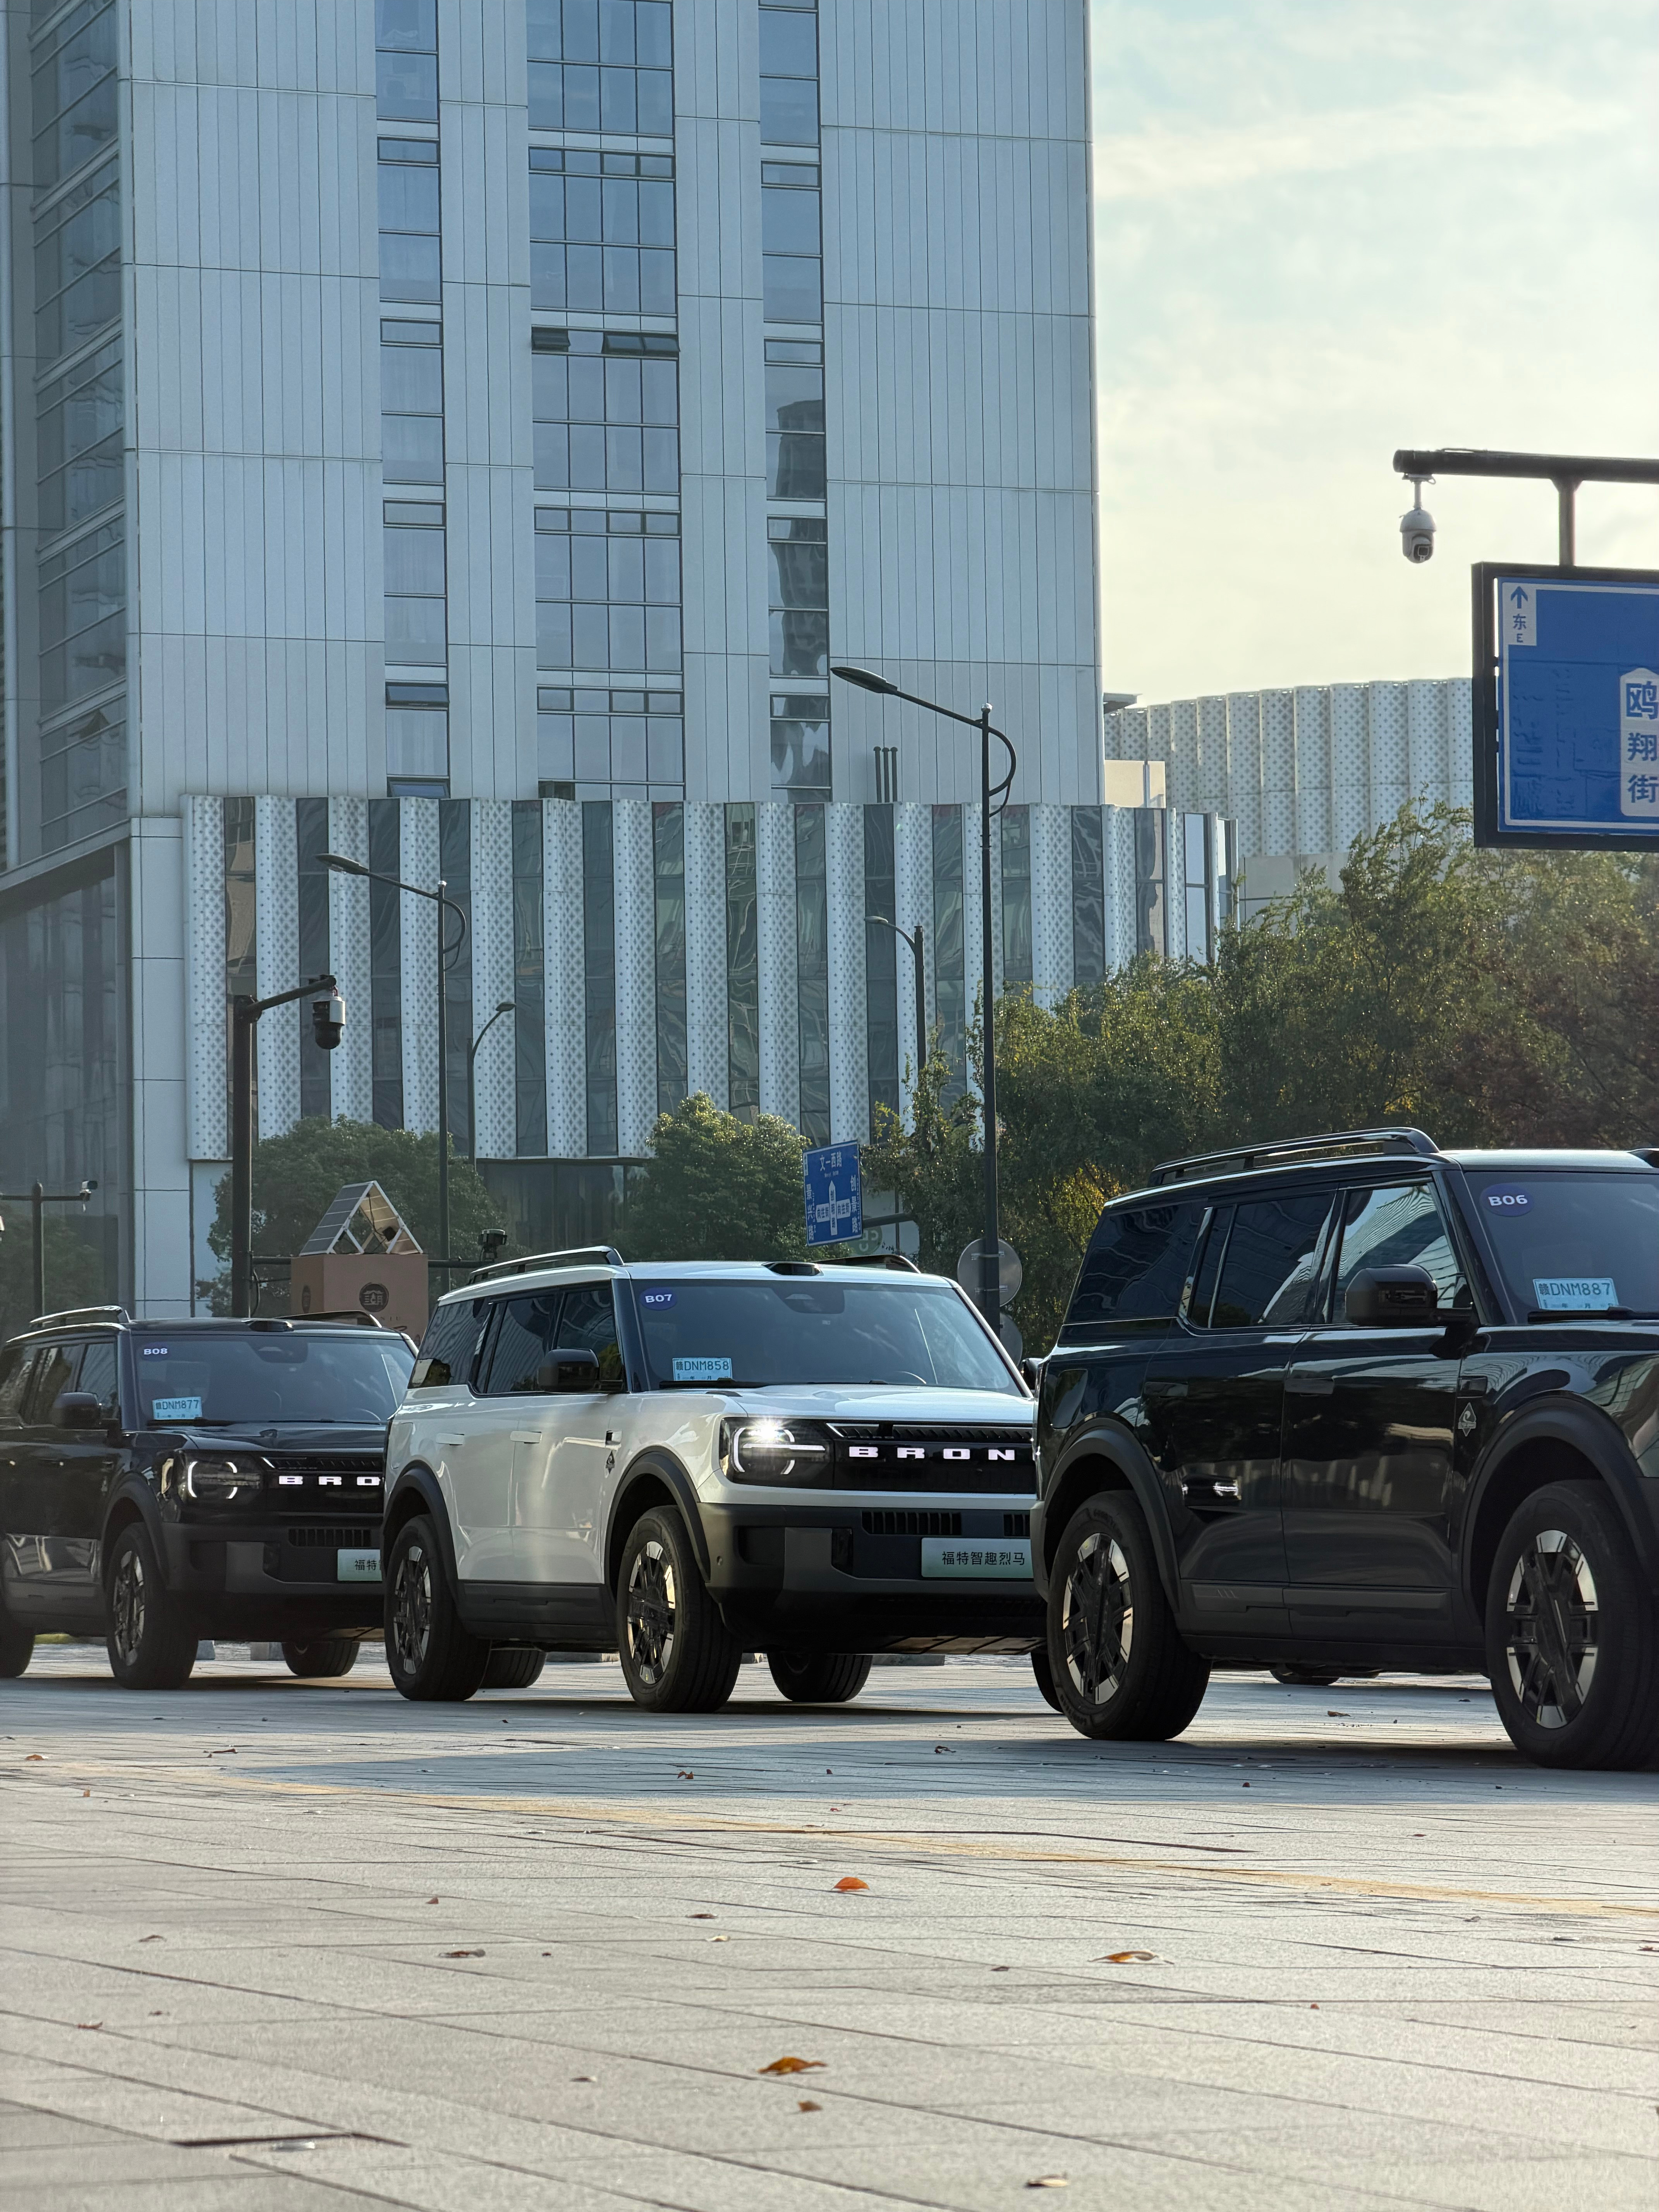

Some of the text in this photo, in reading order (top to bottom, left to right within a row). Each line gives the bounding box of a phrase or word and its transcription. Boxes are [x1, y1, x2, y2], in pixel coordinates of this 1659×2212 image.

[1513, 613, 1527, 630] 东
[1516, 633, 1523, 643] E
[1626, 681, 1659, 803] 鸥翔街
[819, 1151, 842, 1171] 文一西路
[1488, 1195, 1528, 1206] B06
[806, 1183, 814, 1241] 景兴路
[645, 1294, 672, 1303] B07
[156, 1400, 199, 1410] DNM877
[849, 1446, 1015, 1460] BRON
[279, 1476, 380, 1486] BRO
[942, 1551, 1025, 1565] 福特智趣烈马
[355, 1559, 380, 1571] 福特
